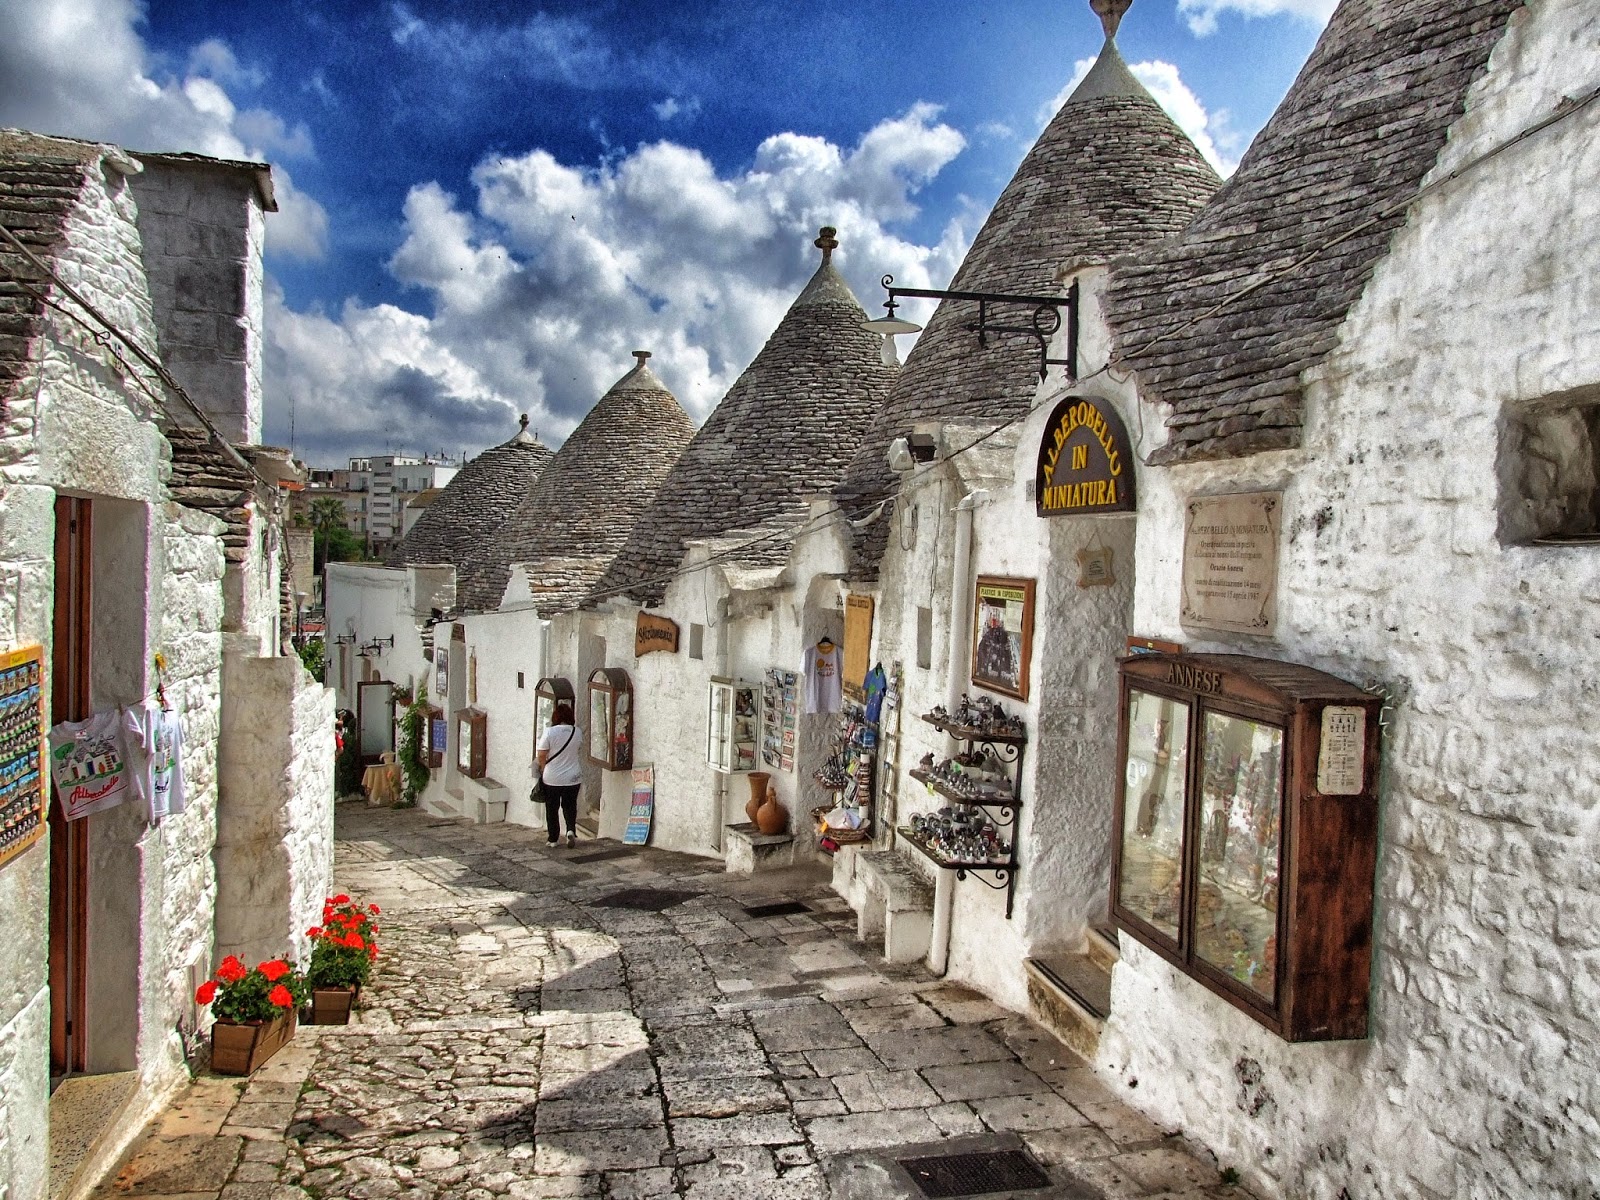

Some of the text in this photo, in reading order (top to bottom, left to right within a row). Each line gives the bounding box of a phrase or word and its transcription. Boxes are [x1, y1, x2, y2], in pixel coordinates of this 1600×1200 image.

[1043, 401, 1122, 486] ALBEROBELLO
[1071, 444, 1088, 470] IN
[1042, 478, 1117, 510] MINIATURA
[1167, 662, 1221, 693] ANNESE
[70, 775, 119, 805] Alberobello
